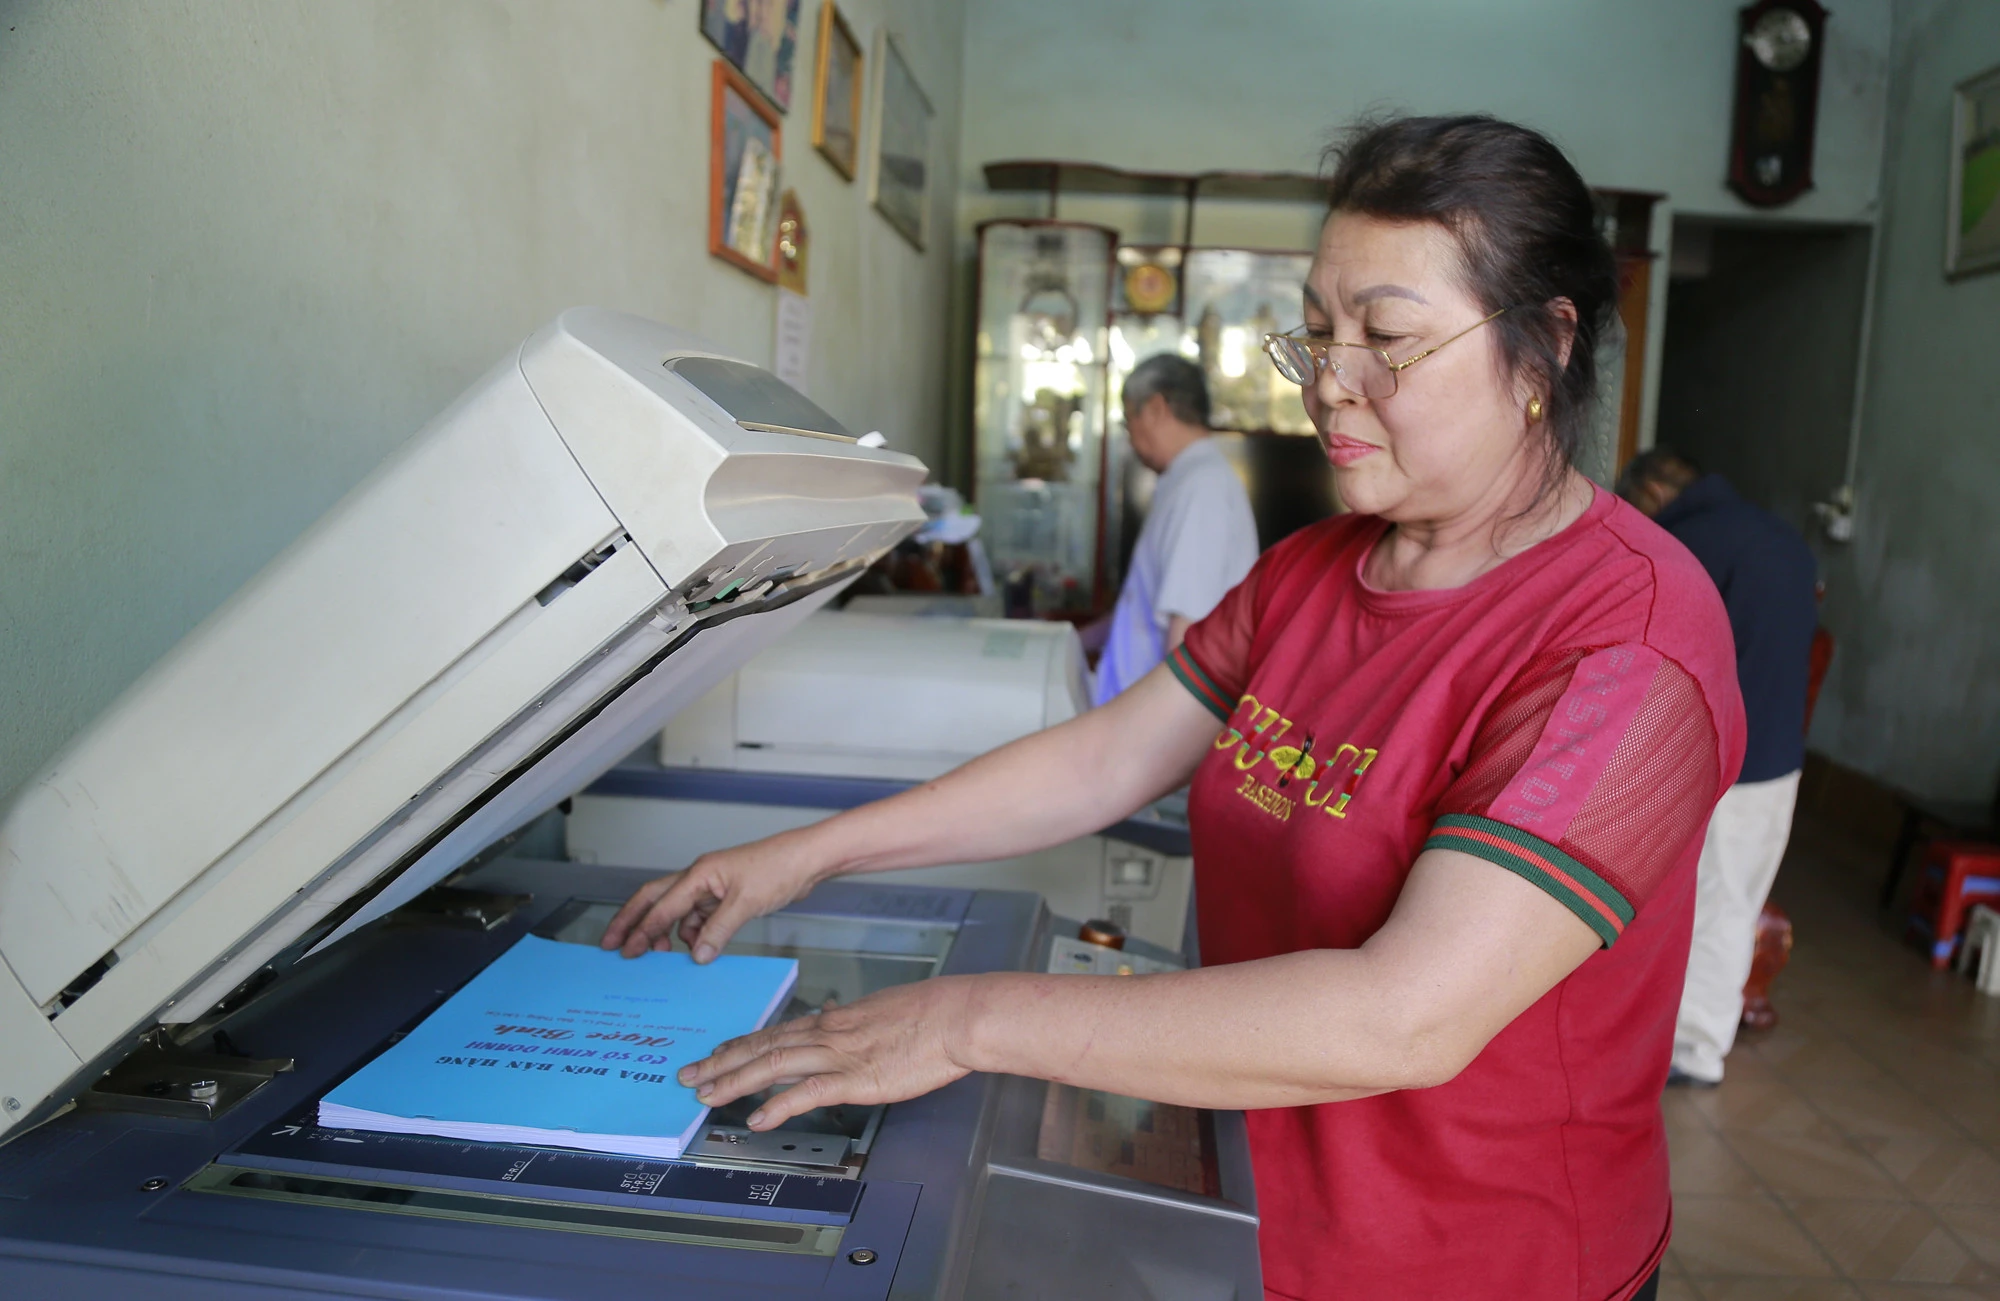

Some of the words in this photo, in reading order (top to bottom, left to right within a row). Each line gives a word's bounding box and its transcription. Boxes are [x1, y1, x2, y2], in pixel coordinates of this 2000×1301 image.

[494, 1024, 575, 1040] Bình
[585, 1031, 675, 1047] Ngọc
[464, 1041, 540, 1053] DOANH
[541, 1046, 599, 1057] KINH
[434, 1056, 500, 1067] HÀNG
[504, 1060, 555, 1071] BÁN
[620, 1069, 667, 1083] HÓA
[620, 1179, 633, 1188] ST
[628, 1179, 645, 1193] LT-R
[748, 1191, 760, 1200] LT
[759, 1191, 772, 1201] LD
